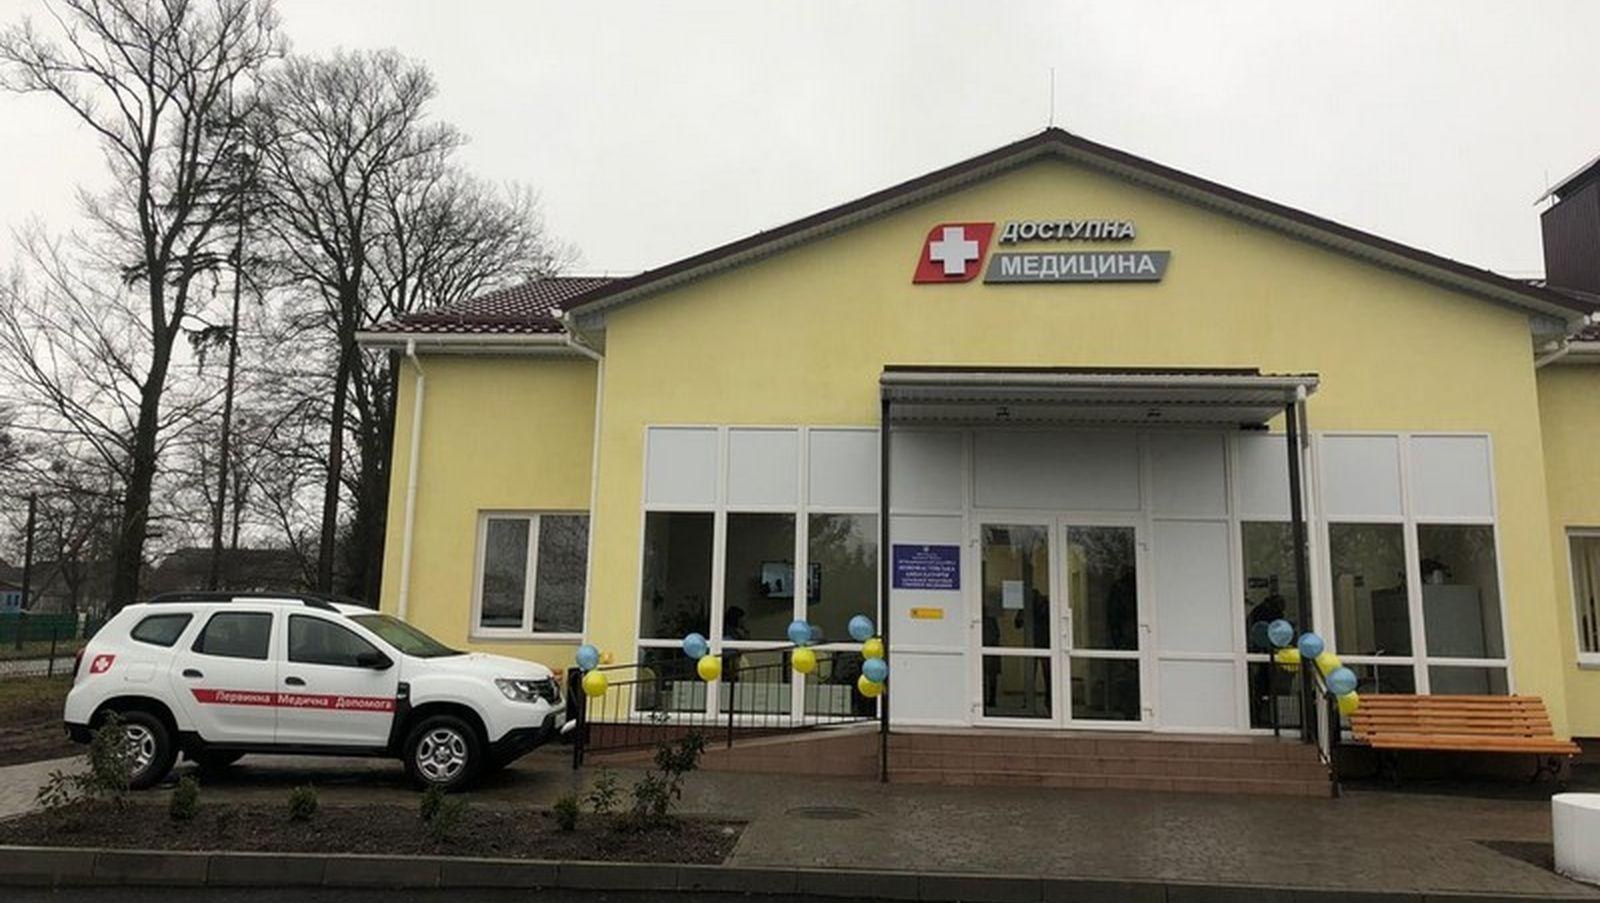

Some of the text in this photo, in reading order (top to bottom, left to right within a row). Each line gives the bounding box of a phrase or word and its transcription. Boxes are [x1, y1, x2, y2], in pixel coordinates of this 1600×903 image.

[999, 221, 1136, 243] ДОСТУПНА
[1001, 254, 1157, 278] МЕДИЦИНА
[215, 690, 392, 710] Первинна Медична Допомога
